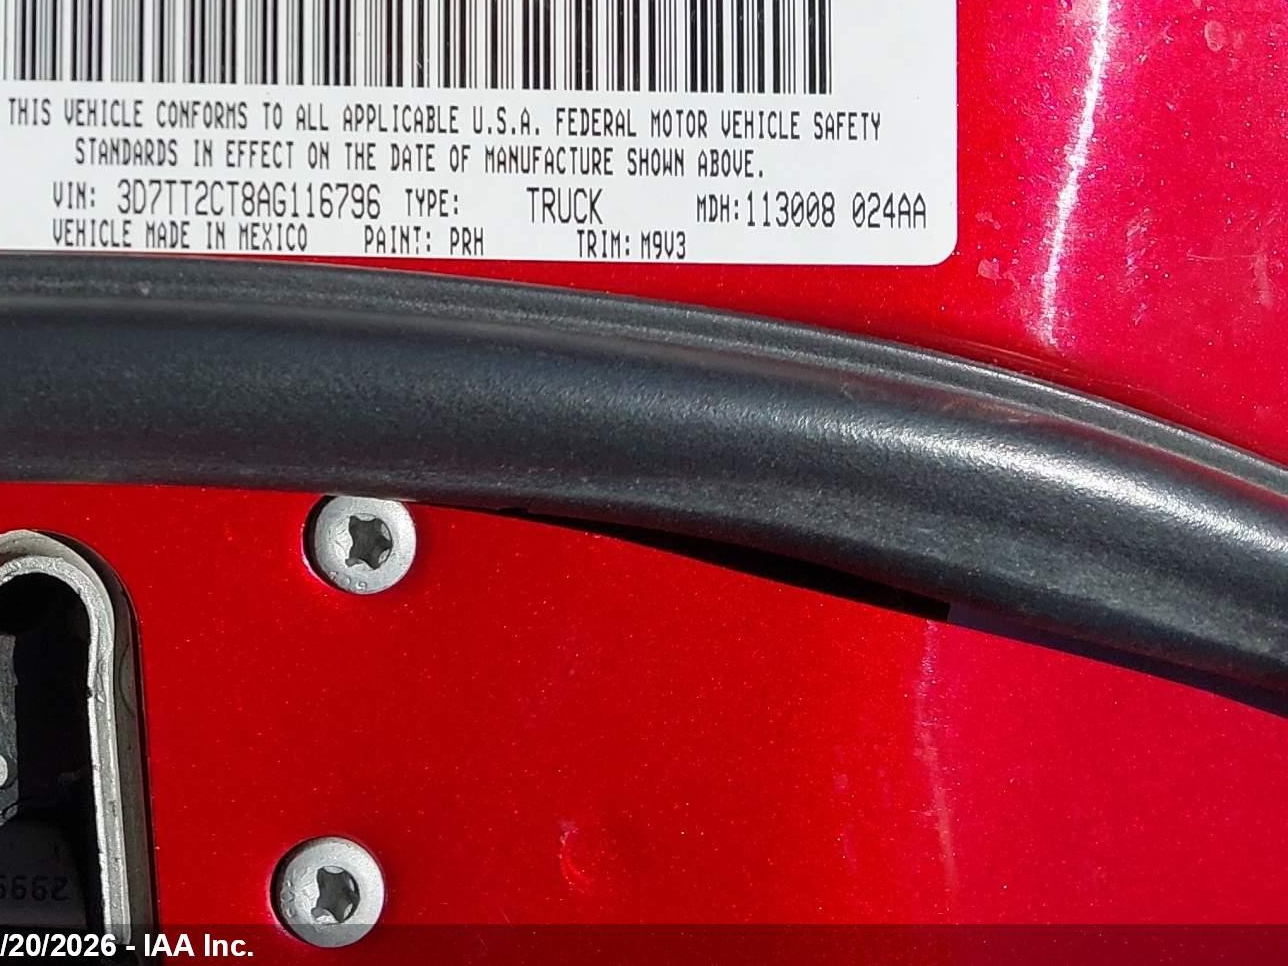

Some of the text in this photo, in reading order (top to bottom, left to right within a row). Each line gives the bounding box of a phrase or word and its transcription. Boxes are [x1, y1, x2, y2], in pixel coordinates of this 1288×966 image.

[9, 98, 880, 140] THIS VEHICLE CONFORMS TO ALL APPLICABLE U.S.A. FEDERAL MOTOR VEHICLE SAFETY
[76, 137, 763, 178] STANDARDS IN EFFECT ON THE DATE OF MANUFACTURE SHOWN ABOVE.
[54, 182, 94, 209] VIN:
[118, 179, 380, 219] 3D7TT2CT8AG116796
[405, 189, 458, 217] TYPE:
[527, 187, 603, 224] TRUCK
[853, 192, 926, 228] 024AA
[53, 219, 685, 258] VEHICLE MADE IN MEXICO PAINT: PRH TRIM: M9V3
